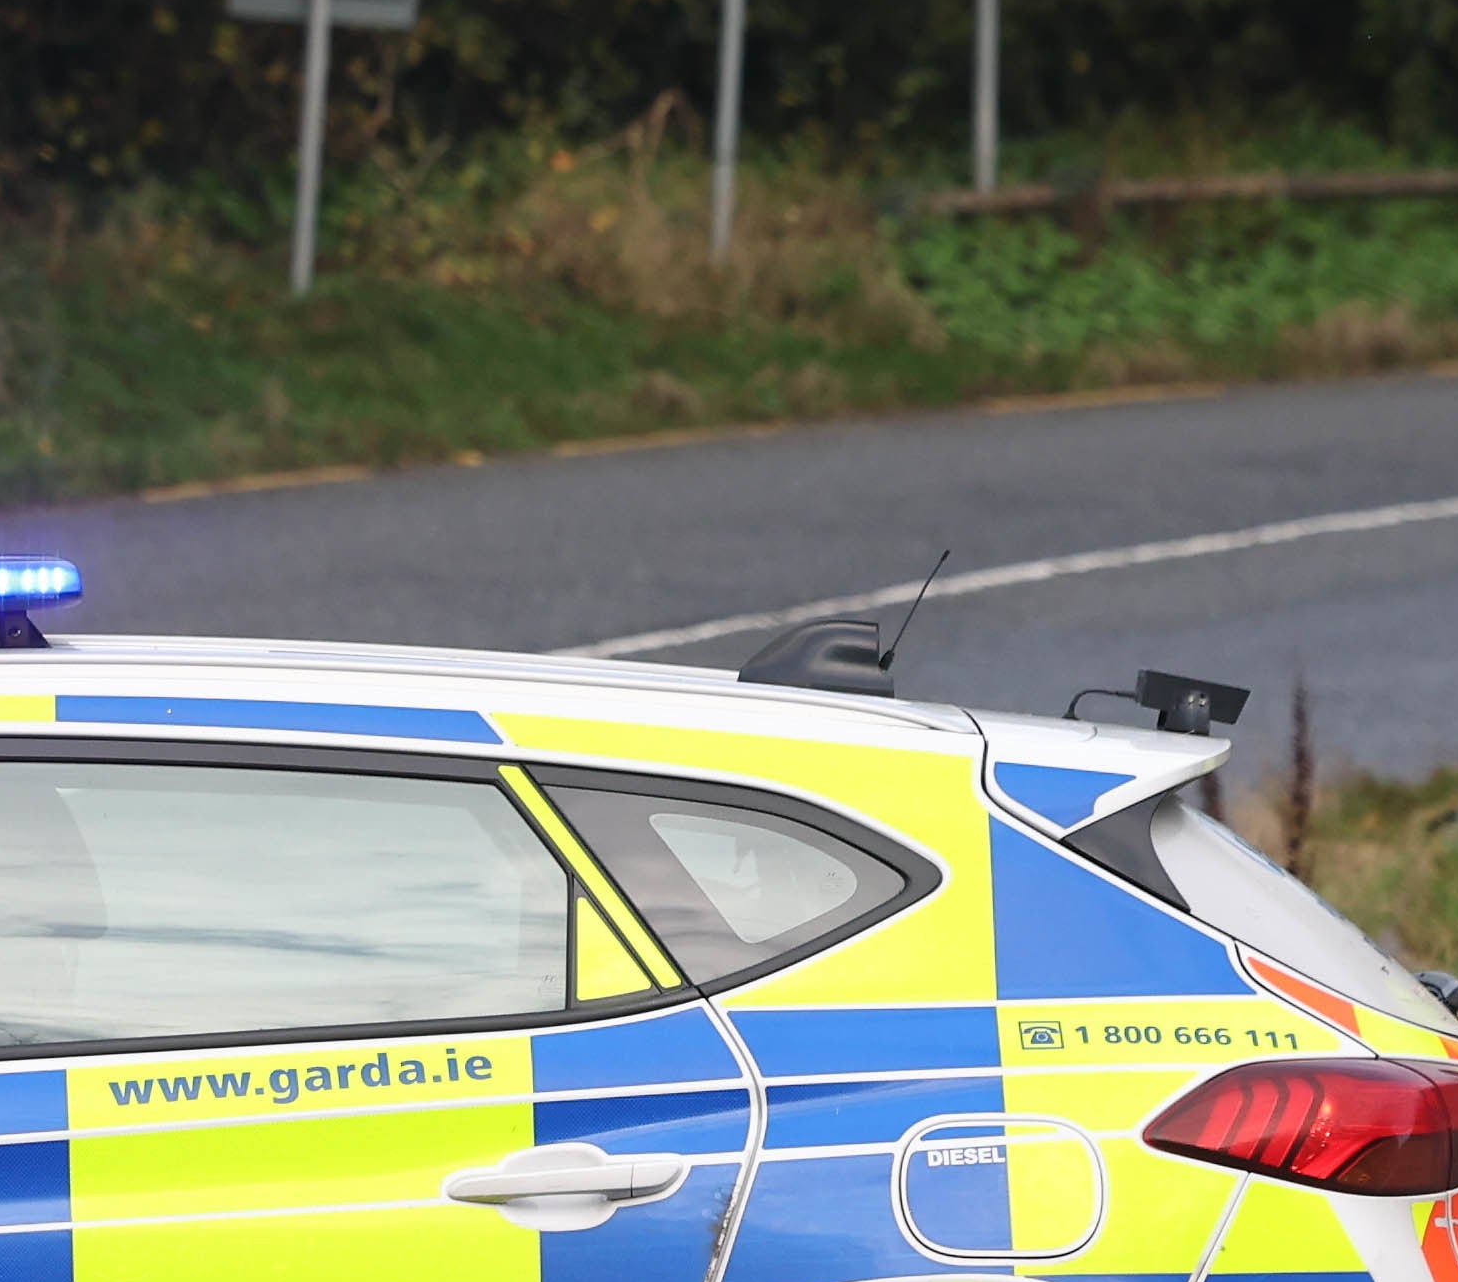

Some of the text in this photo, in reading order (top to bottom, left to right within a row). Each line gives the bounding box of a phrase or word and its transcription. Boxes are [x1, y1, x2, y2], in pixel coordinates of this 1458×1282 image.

[1075, 1025, 1298, 1050] 1 800 666 111
[109, 1048, 493, 1105] www.garda.ie
[927, 1146, 1006, 1167] DIESEL
